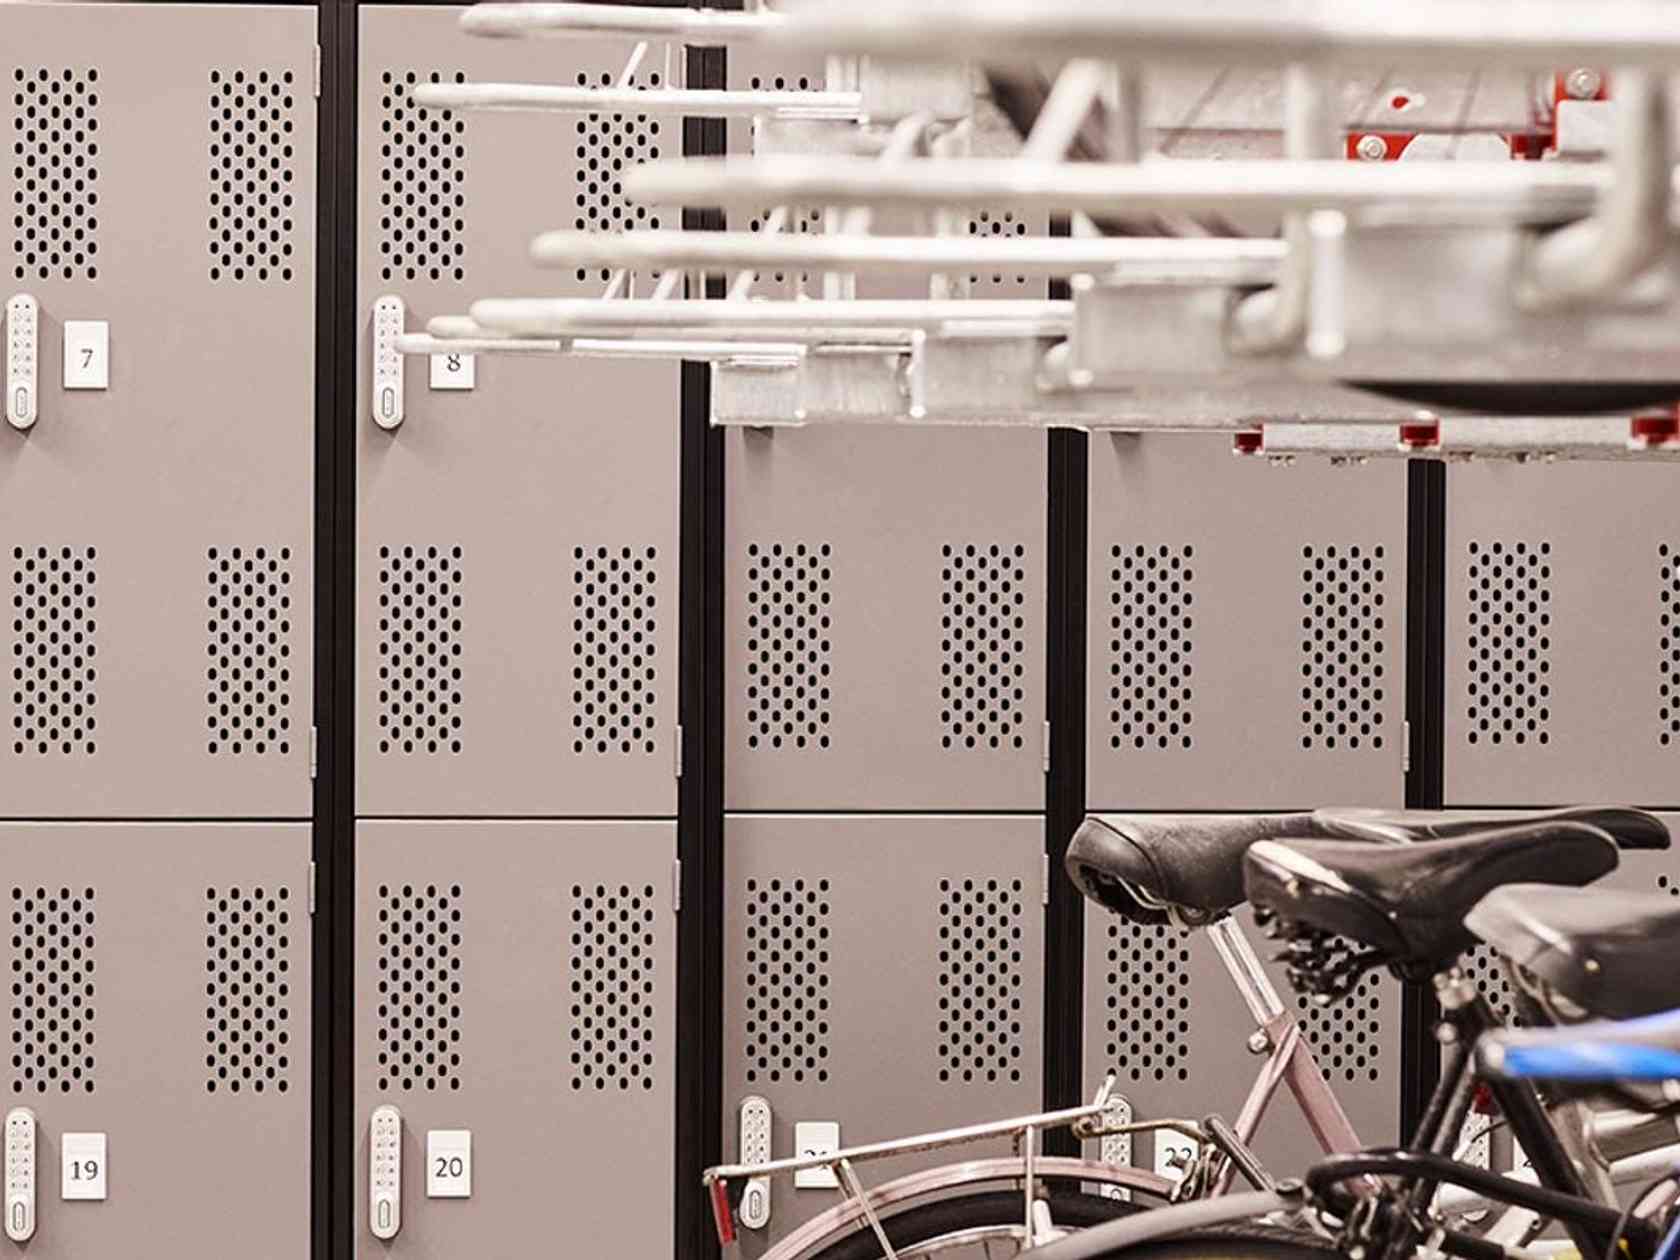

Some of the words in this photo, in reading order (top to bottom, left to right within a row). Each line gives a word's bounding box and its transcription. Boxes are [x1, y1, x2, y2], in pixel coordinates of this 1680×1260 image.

[80, 348, 94, 368] 7
[448, 352, 461, 372] 8
[70, 1160, 98, 1180] 19
[435, 1157, 463, 1177] 20
